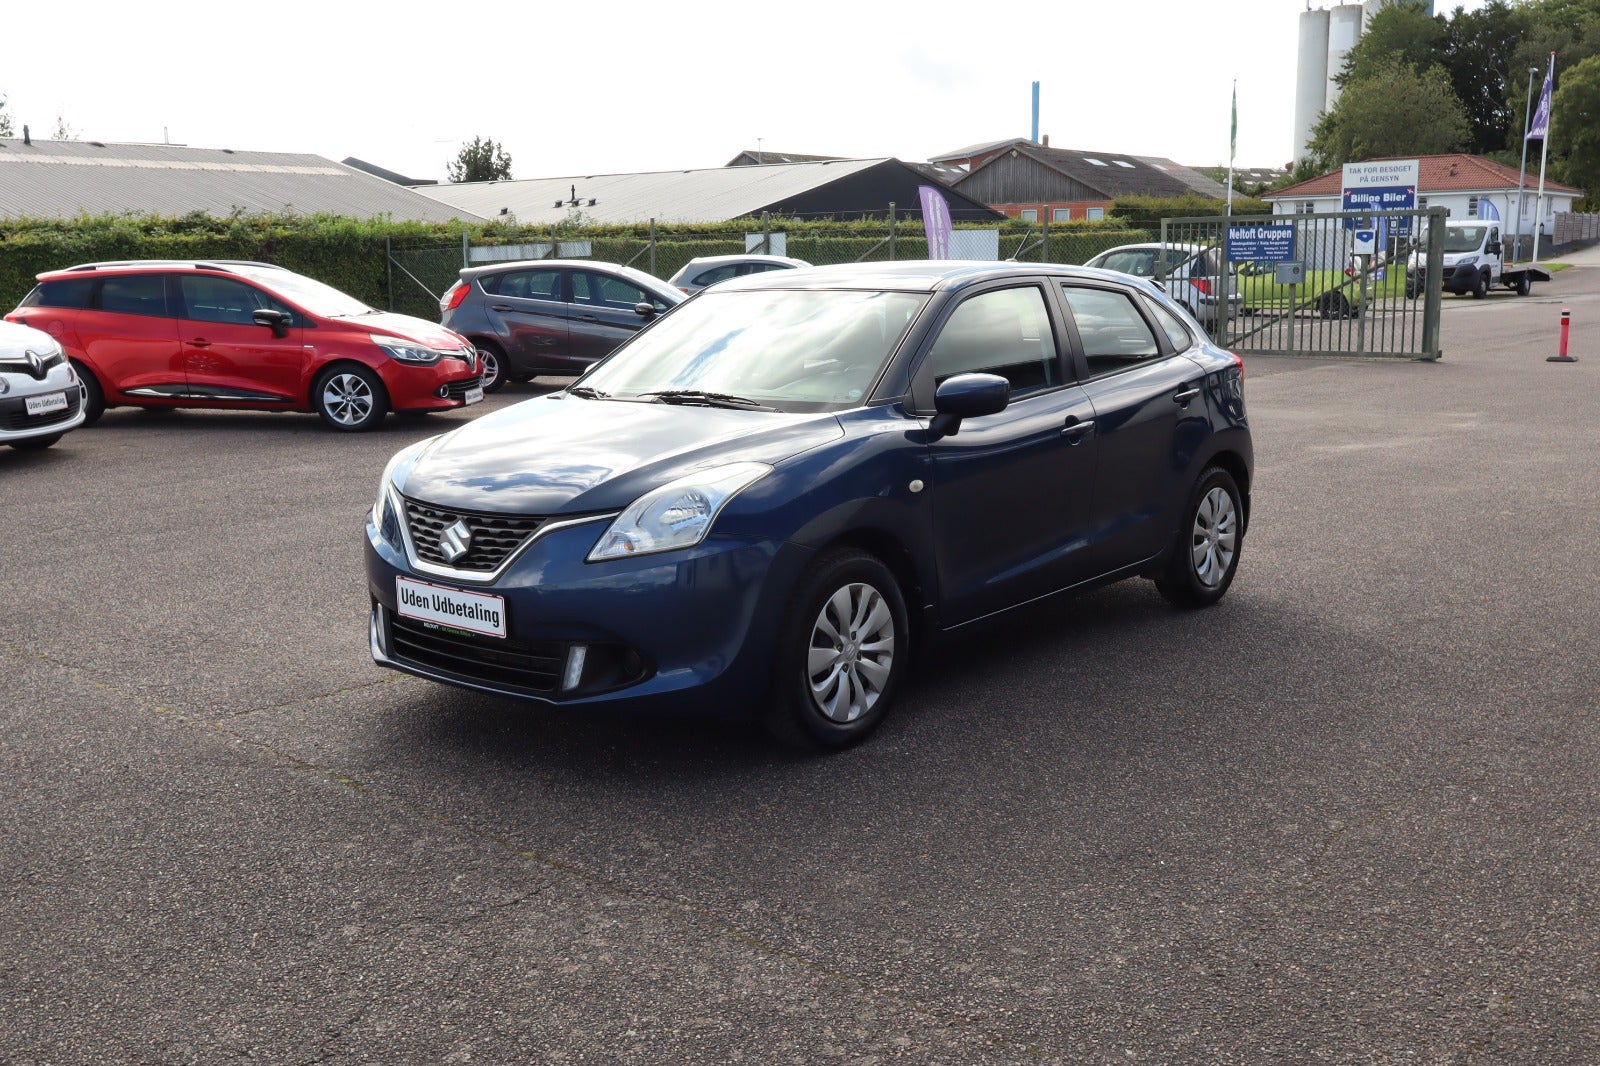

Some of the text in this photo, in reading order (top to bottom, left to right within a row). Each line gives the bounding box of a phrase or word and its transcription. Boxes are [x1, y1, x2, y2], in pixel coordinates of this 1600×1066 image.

[1349, 165, 1412, 175] TAK FOR BESØGET
[1371, 175, 1400, 183] GENSYN
[1350, 193, 1406, 203] Billige Biler
[1229, 227, 1292, 241] Neltoft Gruppen
[28, 398, 66, 410] Uden Udbetaling
[400, 587, 500, 628] Uden Udbetaling
